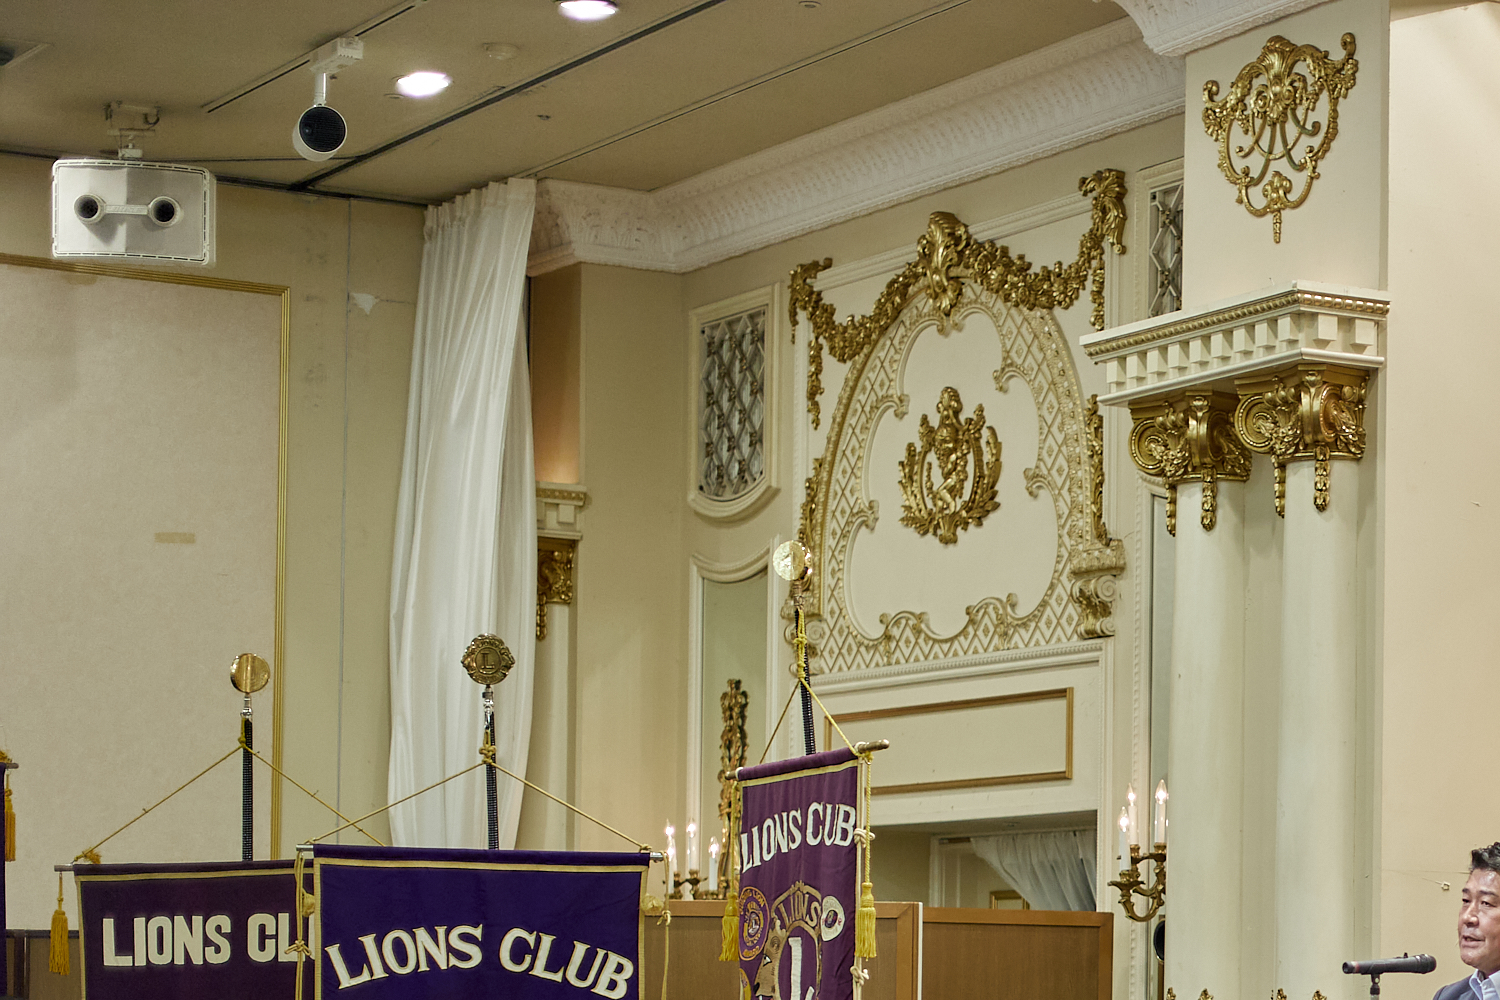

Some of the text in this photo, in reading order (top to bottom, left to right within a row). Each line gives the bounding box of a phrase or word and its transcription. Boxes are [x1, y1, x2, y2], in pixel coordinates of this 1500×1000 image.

[741, 808, 801, 873] LIONS
[102, 912, 315, 967] LIONS CL
[324, 923, 635, 1000] LIONS CLUB
